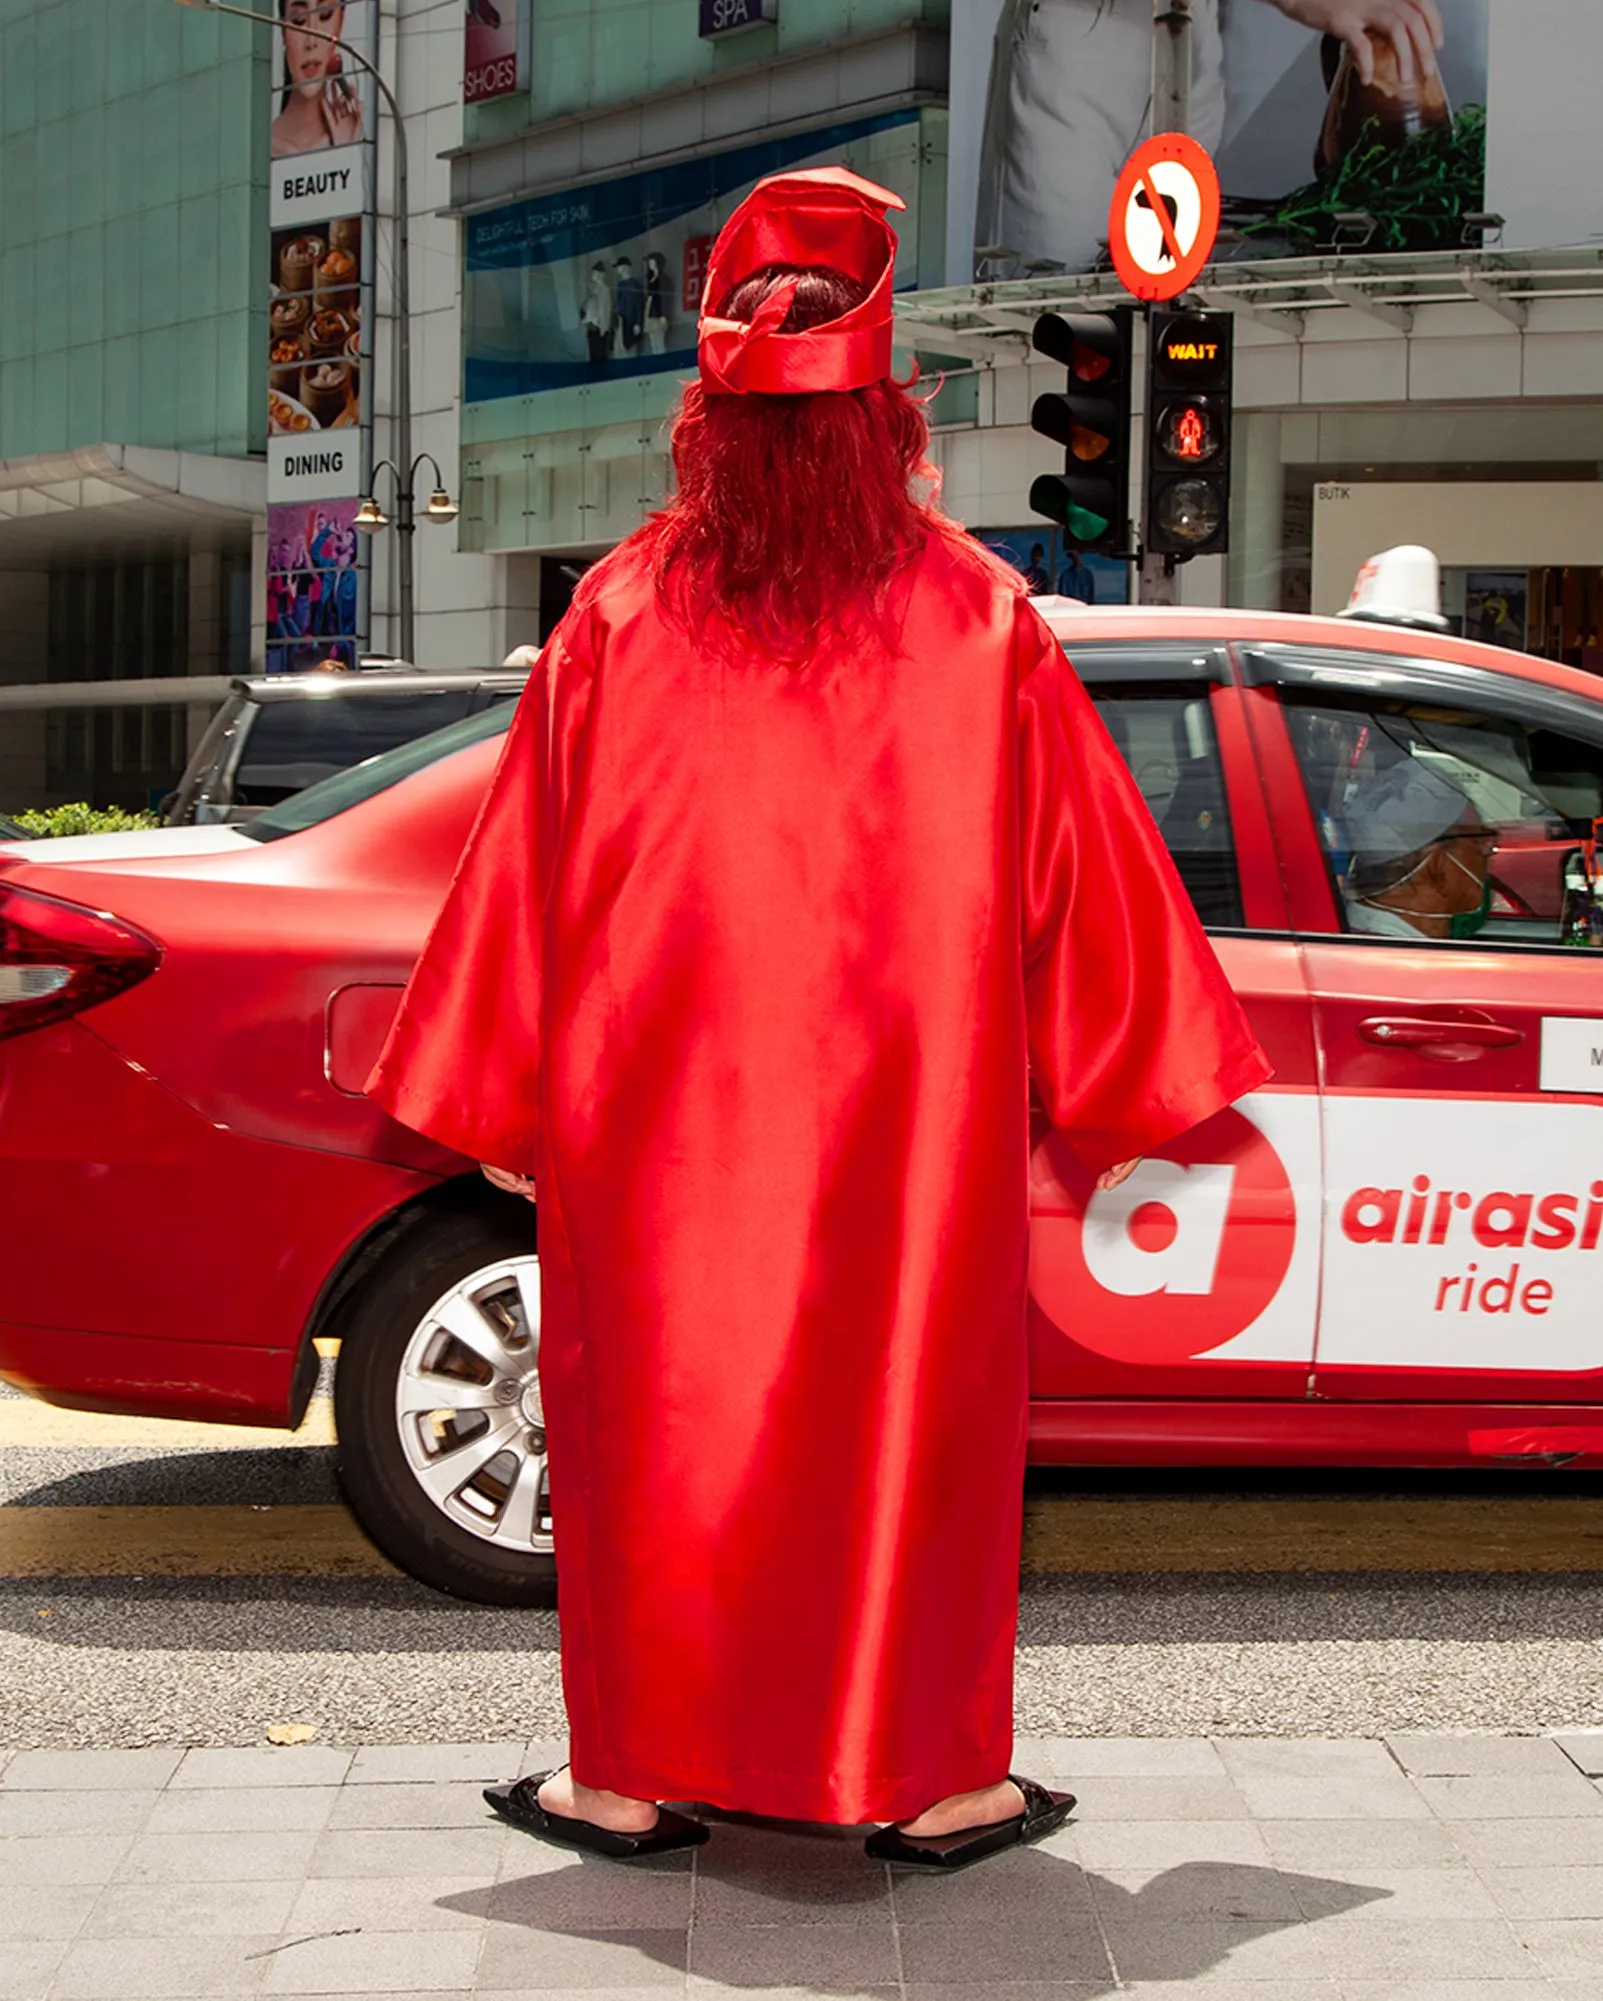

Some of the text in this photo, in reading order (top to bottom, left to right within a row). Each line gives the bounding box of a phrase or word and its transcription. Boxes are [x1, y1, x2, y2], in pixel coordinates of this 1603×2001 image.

[713, 0, 748, 29] SPA
[465, 59, 514, 97] SHOES
[284, 167, 351, 200] BEAUTY
[527, 213, 549, 232] TECH
[550, 207, 568, 226] FOR
[569, 203, 590, 223] SKIN
[1167, 343, 1218, 360] WAIT
[284, 451, 344, 477] DINING
[1432, 1262, 1554, 1316] ride
